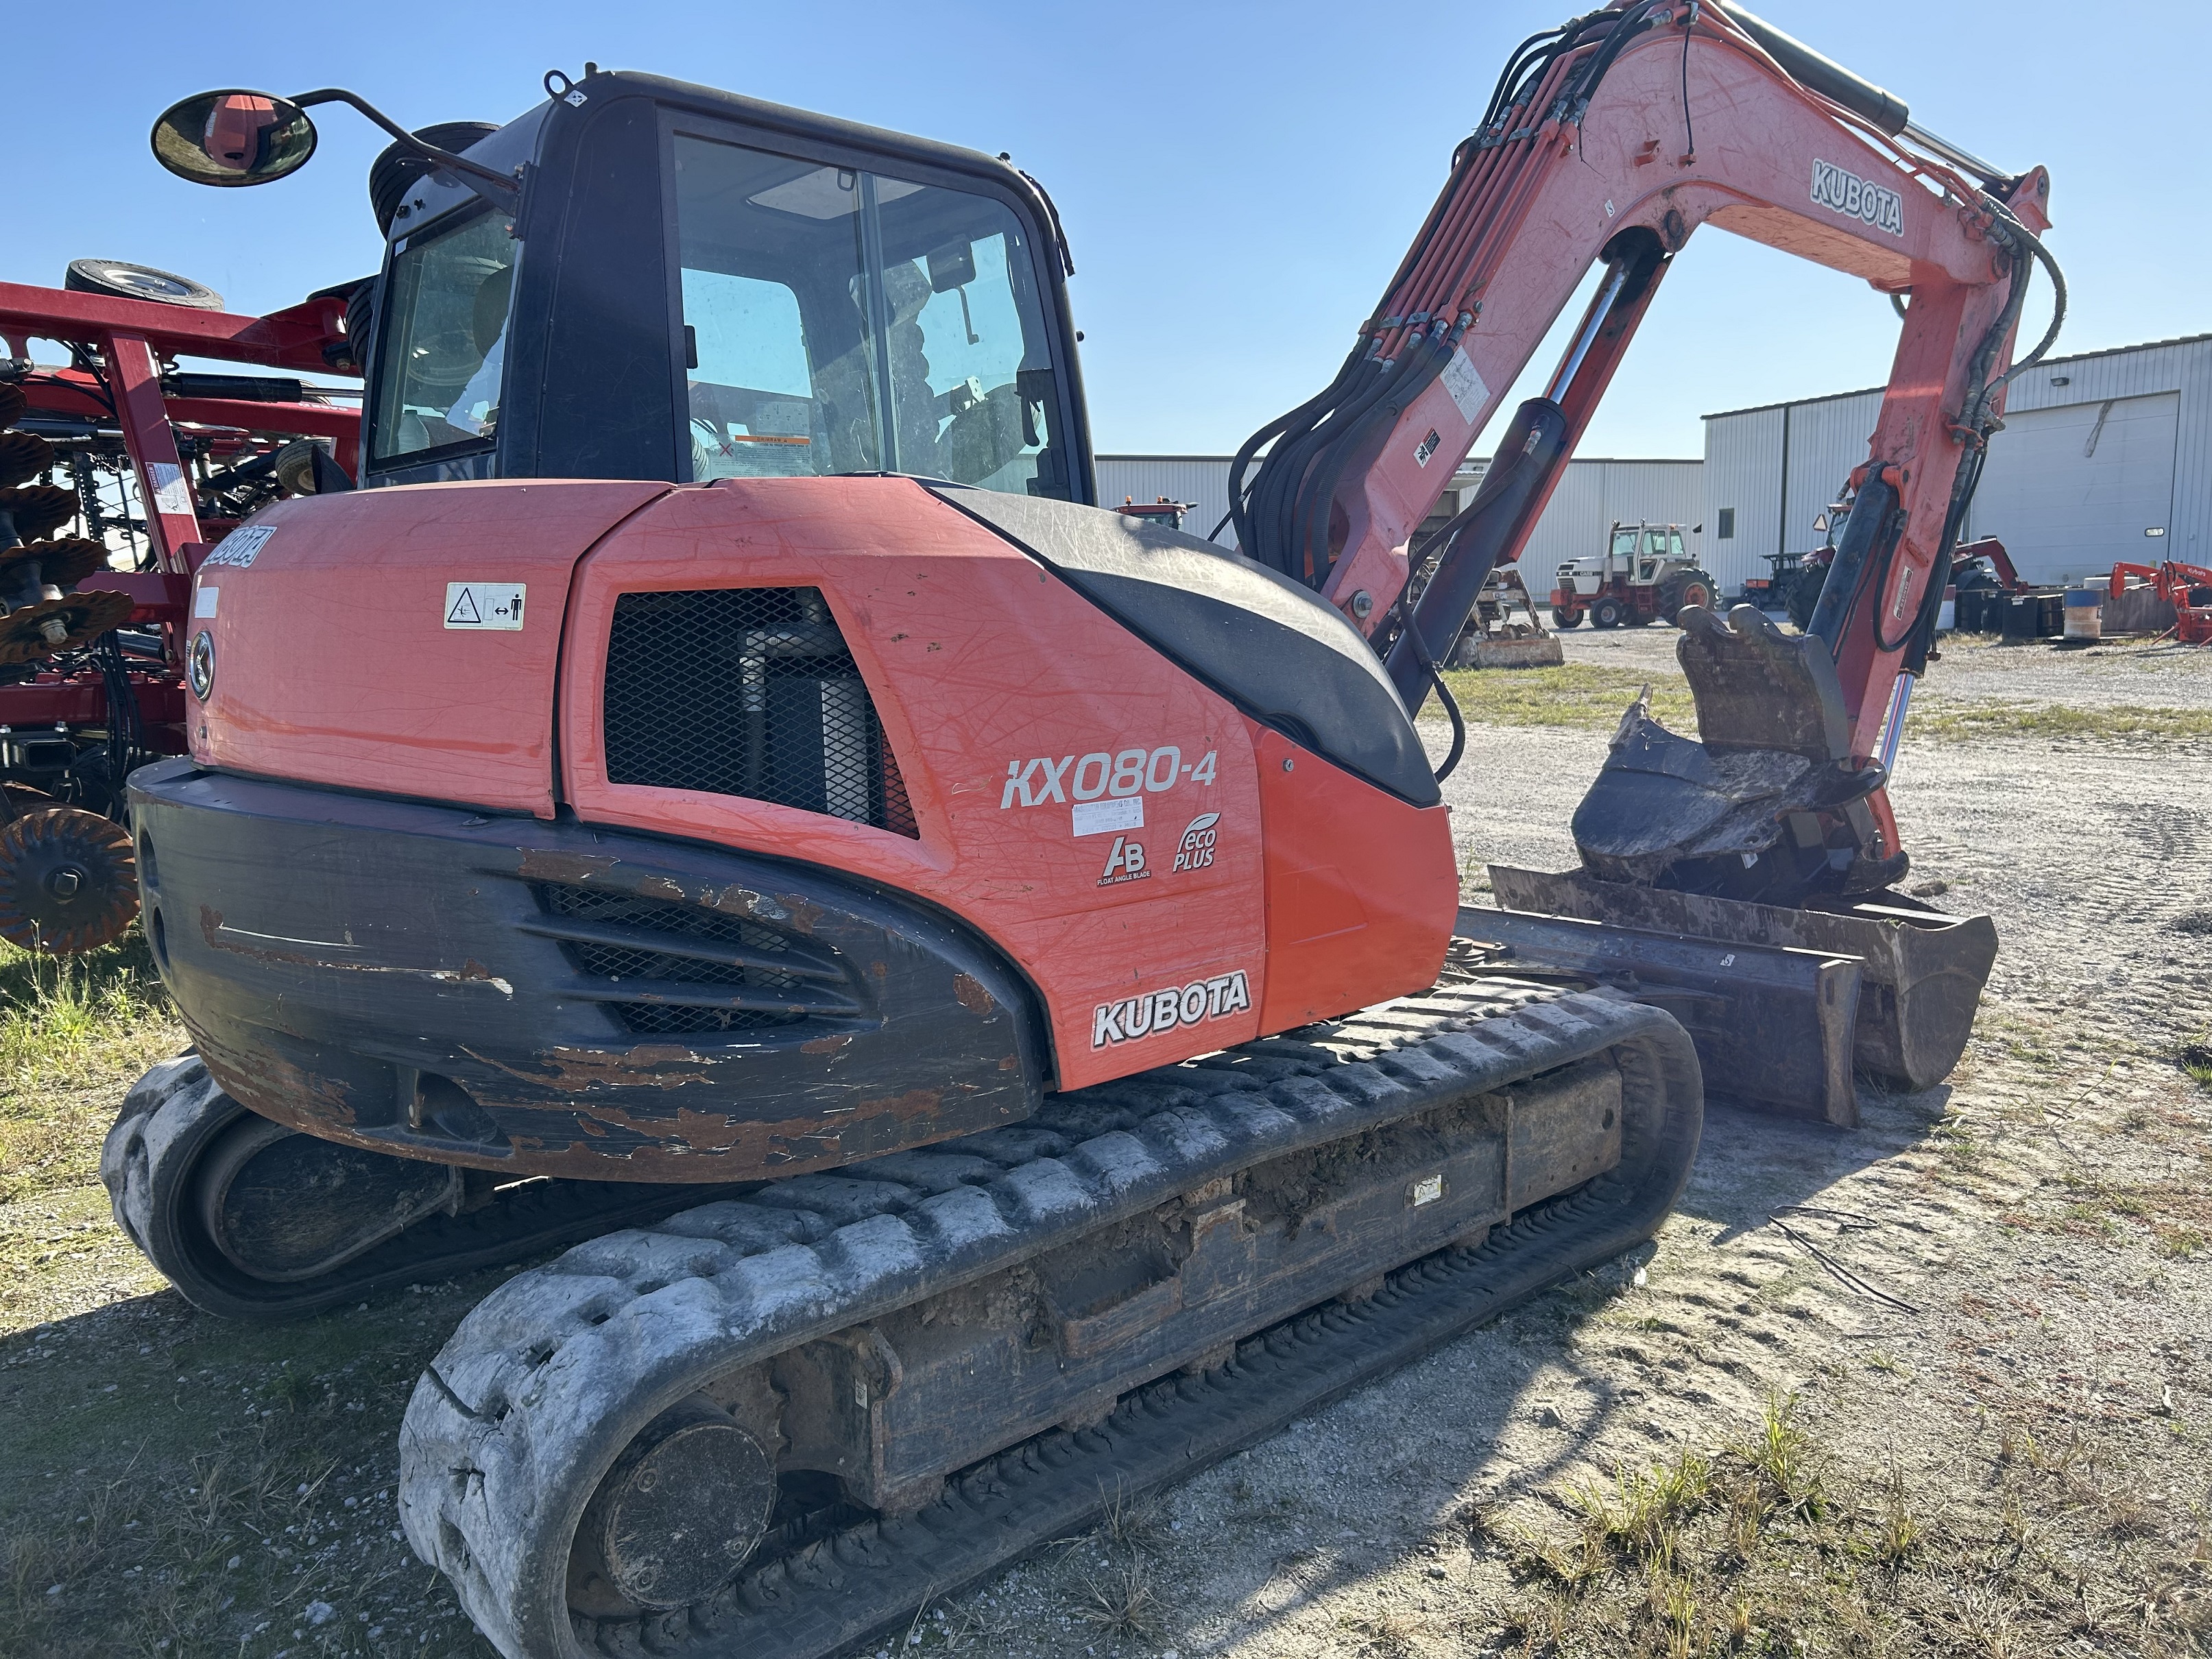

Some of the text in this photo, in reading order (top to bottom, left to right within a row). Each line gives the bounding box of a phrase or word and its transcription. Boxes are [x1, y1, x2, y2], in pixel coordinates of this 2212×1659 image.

[1812, 162, 1902, 234] KUBOTA
[2187, 567, 2206, 577] Kubota
[1000, 746, 1217, 809] KX080-4
[1185, 828, 1216, 851] eco
[1103, 836, 1146, 877] AB
[1173, 847, 1215, 872] PLUS
[1097, 871, 1151, 886] FLOAT ANGLE BLADE
[1094, 973, 1248, 1046] KUBOTA
